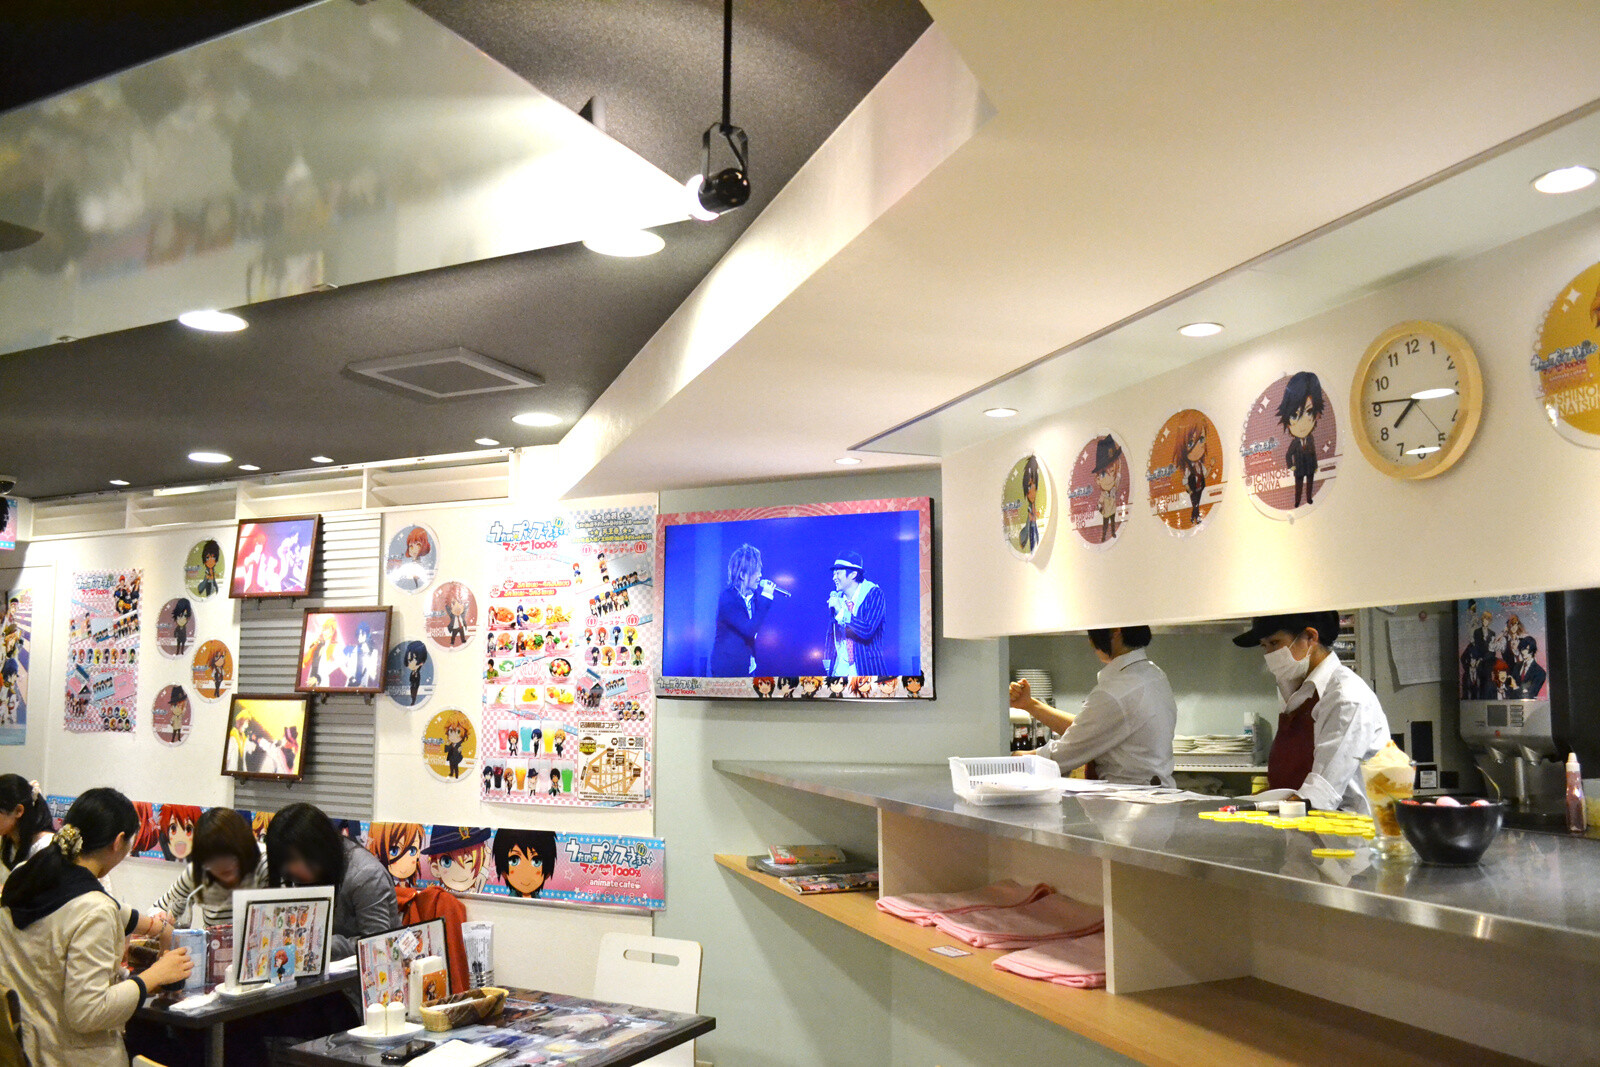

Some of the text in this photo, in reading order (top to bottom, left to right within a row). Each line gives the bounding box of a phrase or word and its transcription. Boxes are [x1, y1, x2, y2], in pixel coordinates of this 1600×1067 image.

[1405, 339, 1420, 354] 12
[1430, 340, 1436, 354] 1
[1388, 352, 1399, 367] 11
[1375, 376, 1389, 391] 10
[1373, 403, 1382, 417] 9
[1380, 427, 1389, 441] 8
[1396, 443, 1405, 457] 7
[1253, 468, 1290, 484] ICHINOSE
[590, 879, 635, 889] animate cafe
